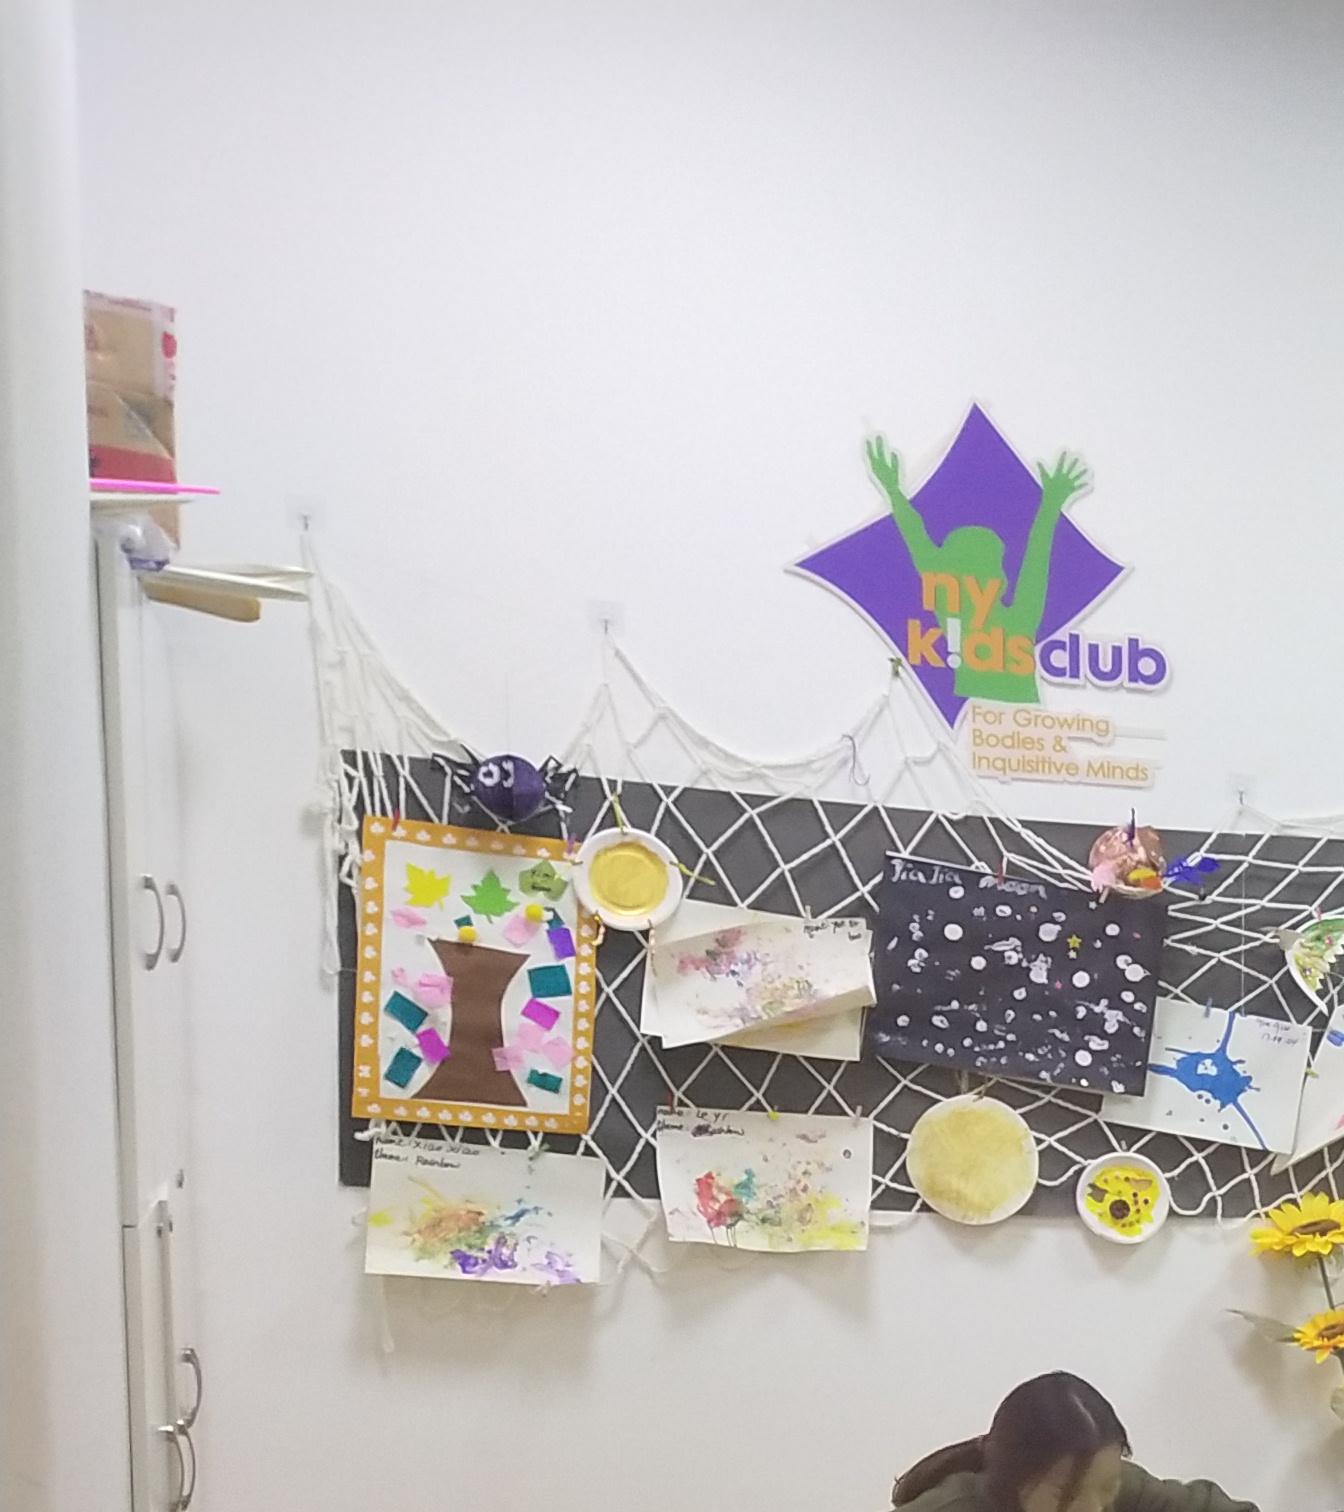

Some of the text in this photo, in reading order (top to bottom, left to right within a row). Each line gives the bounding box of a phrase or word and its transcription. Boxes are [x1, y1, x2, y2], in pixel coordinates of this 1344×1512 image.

[922, 572, 1001, 630] ny
[972, 705, 1110, 737] For Growing
[972, 728, 1068, 753] Bodies &
[972, 752, 1149, 781] Inquisitive Minds
